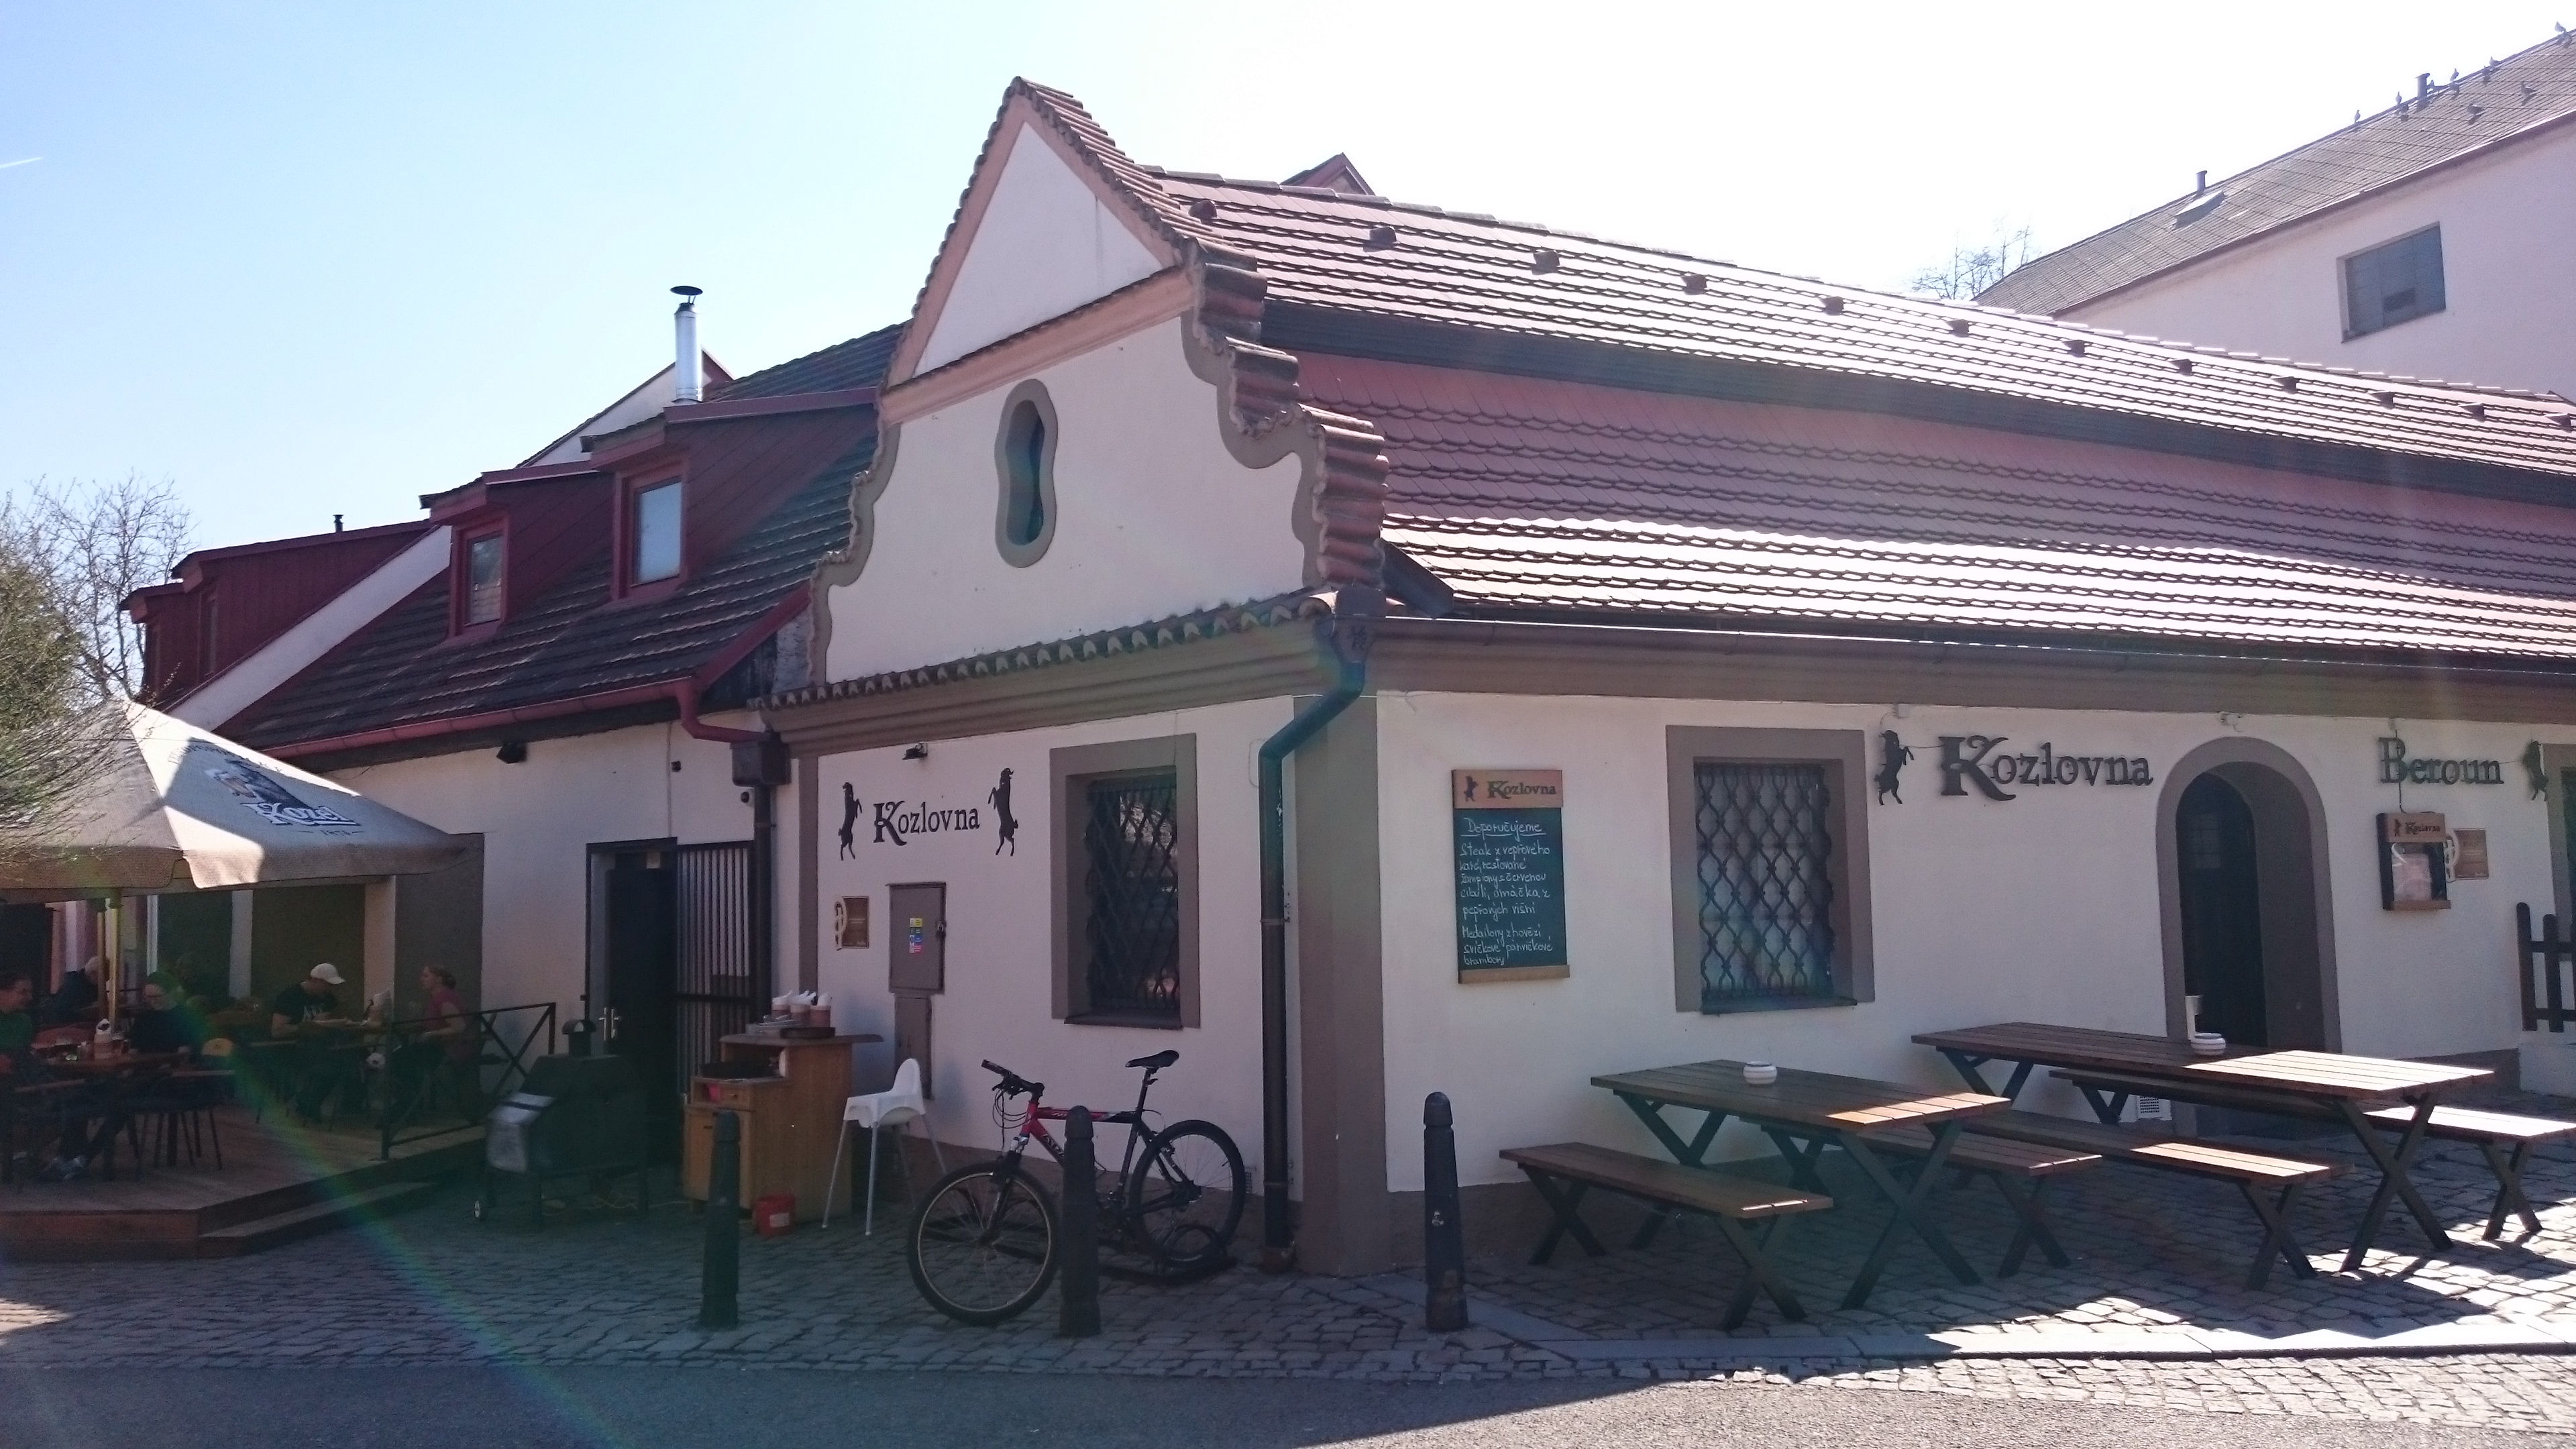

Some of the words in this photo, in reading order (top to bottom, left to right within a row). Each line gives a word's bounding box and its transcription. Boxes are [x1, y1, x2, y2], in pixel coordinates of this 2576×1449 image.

[1939, 735, 2153, 801] Kozlovna
[2379, 737, 2504, 785] Beroun
[1487, 781, 1556, 799] Kozlovna
[239, 802, 361, 826] Kozel
[873, 801, 980, 846] Kozlovna
[1464, 818, 1542, 842] Doporučujeme
[1460, 842, 1491, 855] Steak
